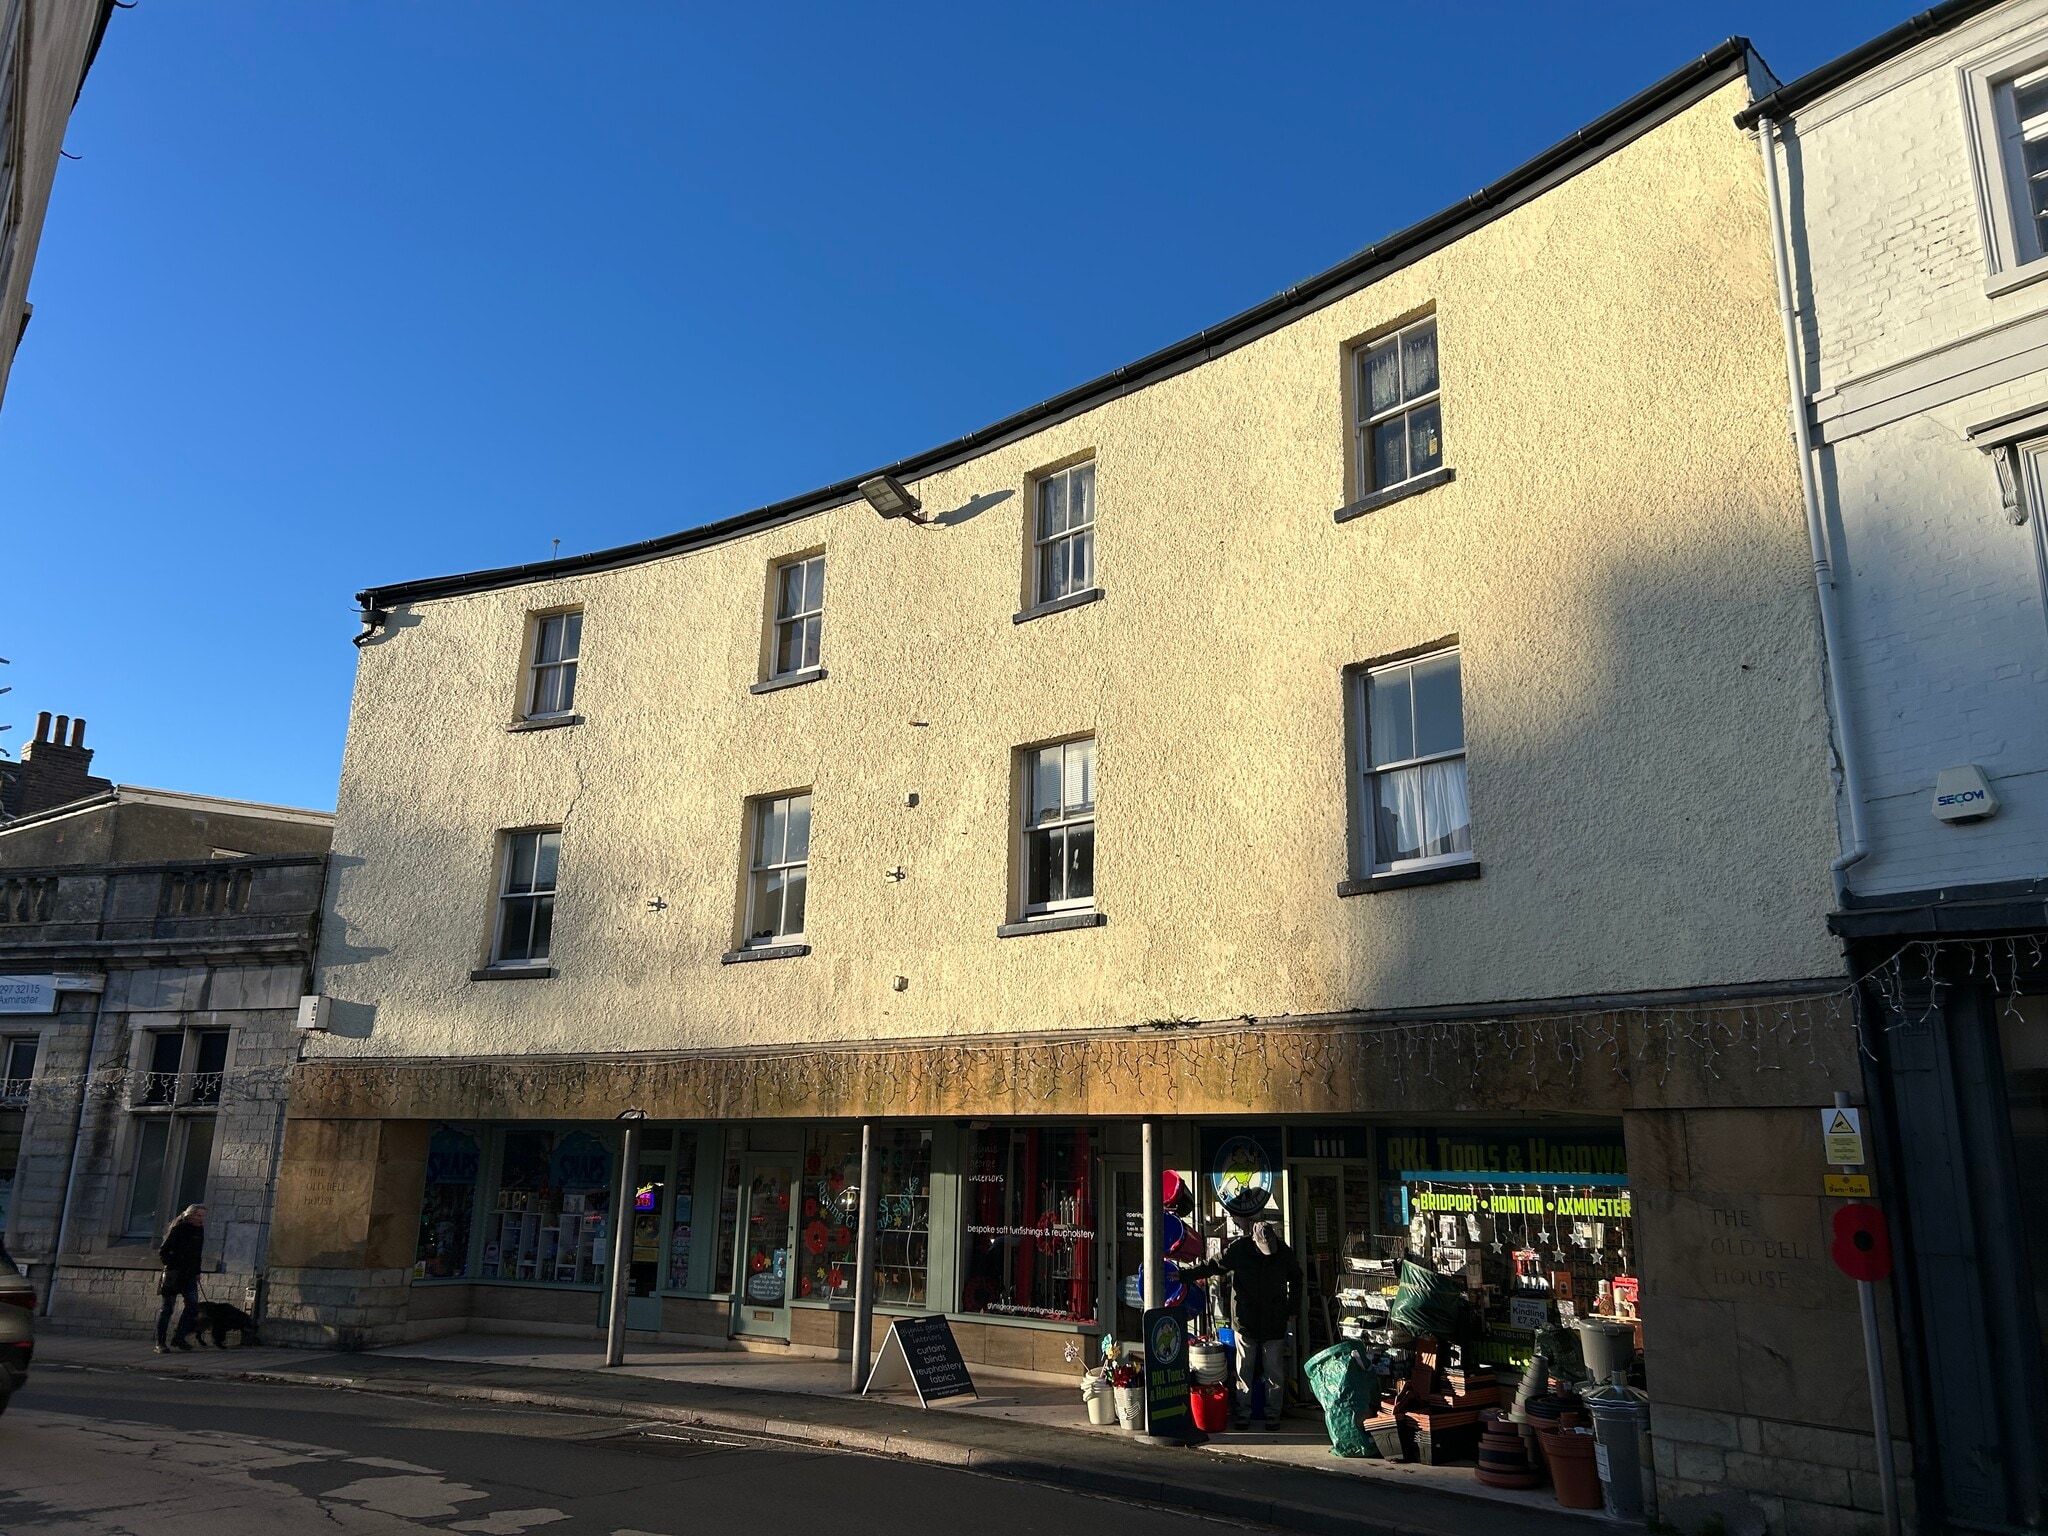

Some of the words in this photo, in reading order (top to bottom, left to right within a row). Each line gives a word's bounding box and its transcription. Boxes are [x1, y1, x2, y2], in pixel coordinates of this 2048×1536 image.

[1938, 790, 1984, 806] SECOM
[15, 984, 40, 994] 32115
[969, 1143, 998, 1158] glynis
[1388, 1137, 1432, 1170] RKL
[1506, 1145, 1525, 1172] &
[559, 1154, 606, 1181] SNAPS
[970, 1159, 996, 1171] george
[309, 1168, 326, 1177] THE
[969, 1174, 1004, 1182] interiors
[307, 1182, 323, 1191] OLD
[304, 1196, 334, 1206] HOUSE
[1420, 1193, 1479, 1212] BRIDPORT
[1490, 1195, 1544, 1214] HONITON
[1557, 1197, 1632, 1217] AXMINSTER
[1708, 1209, 1751, 1226] THE
[967, 1224, 995, 1235] bespoke
[996, 1226, 1009, 1234] soft
[1045, 1228, 1050, 1236] &
[1711, 1237, 1755, 1256] OLD
[1764, 1240, 1818, 1260] BELL
[1713, 1265, 1790, 1289] HOUSE
[1513, 1307, 1545, 1320] Kindling
[1518, 1316, 1539, 1326] £7.50
[900, 1325, 924, 1337] glynis
[1493, 1331, 1531, 1339] KINDLING
[917, 1344, 946, 1355] curtains
[923, 1353, 946, 1364] blinds
[916, 1361, 962, 1376] reupholstery
[929, 1373, 956, 1384] fabrics
[1152, 1370, 1166, 1386] RKL
[1150, 1390, 1155, 1402] &
